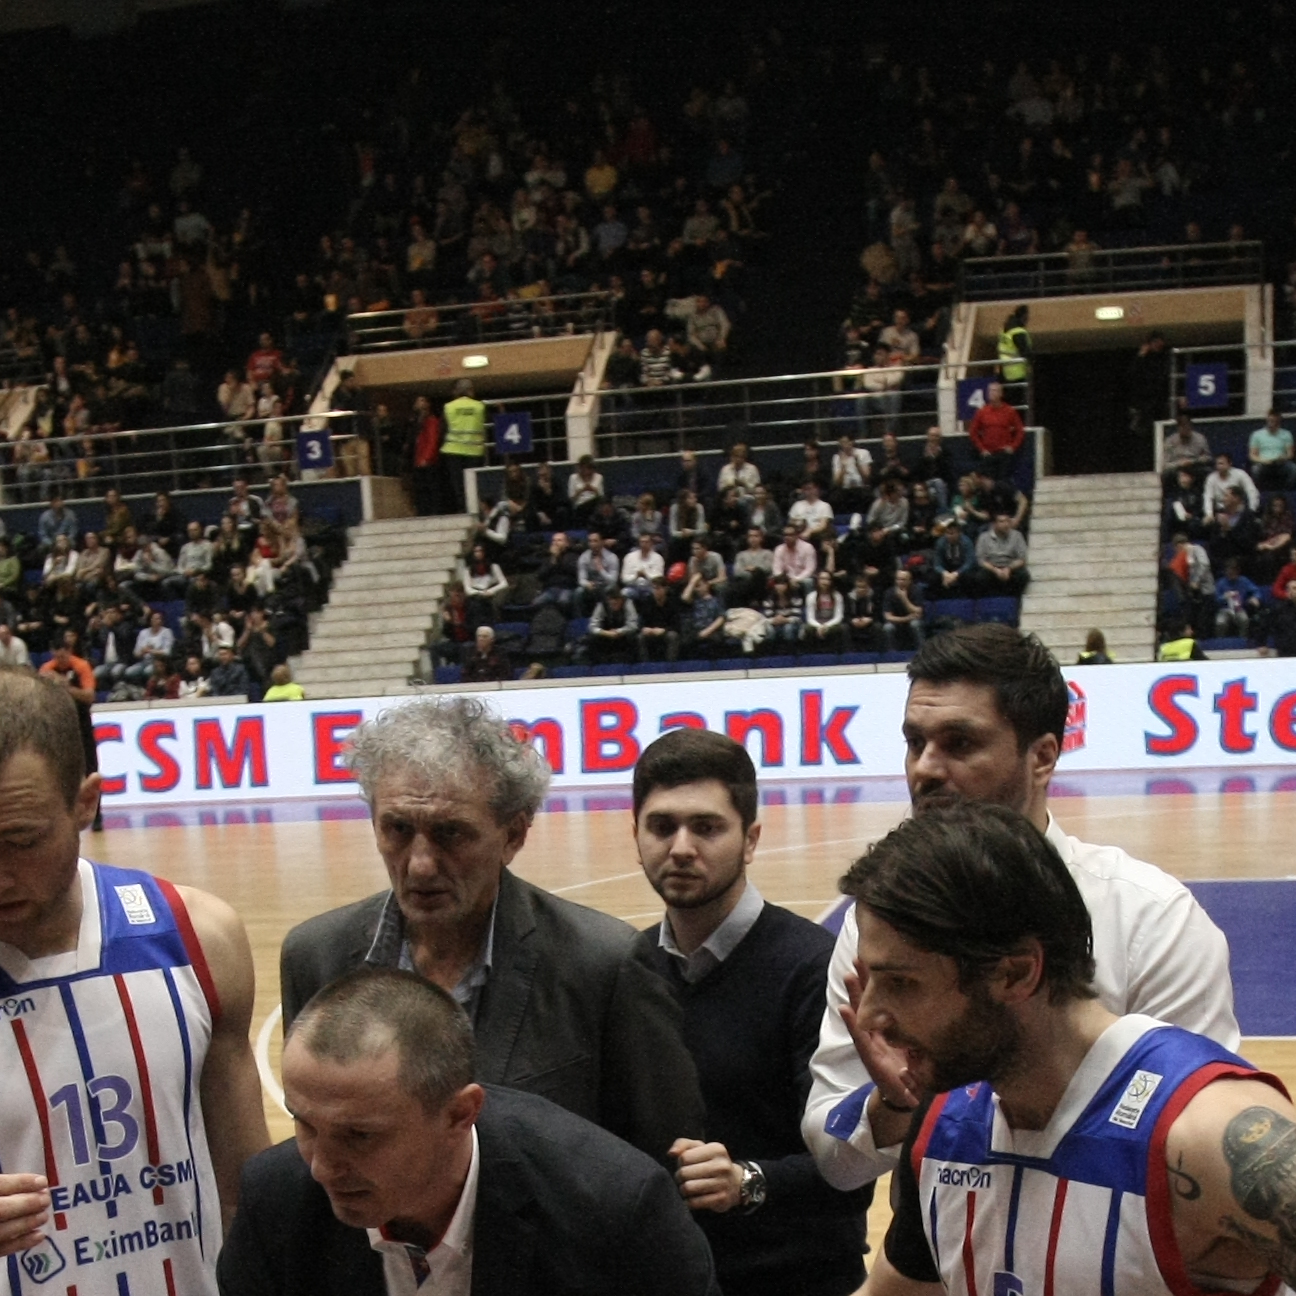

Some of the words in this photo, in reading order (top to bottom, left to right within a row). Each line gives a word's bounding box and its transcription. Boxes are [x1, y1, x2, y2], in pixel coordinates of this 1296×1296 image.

[1198, 374, 1216, 396] 5
[967, 389, 986, 408] 4
[503, 423, 522, 444] 4
[306, 440, 322, 460] 3
[48, 1075, 140, 1166] 13
[50, 1178, 132, 1212] EAUA
[139, 1159, 194, 1188] CSM
